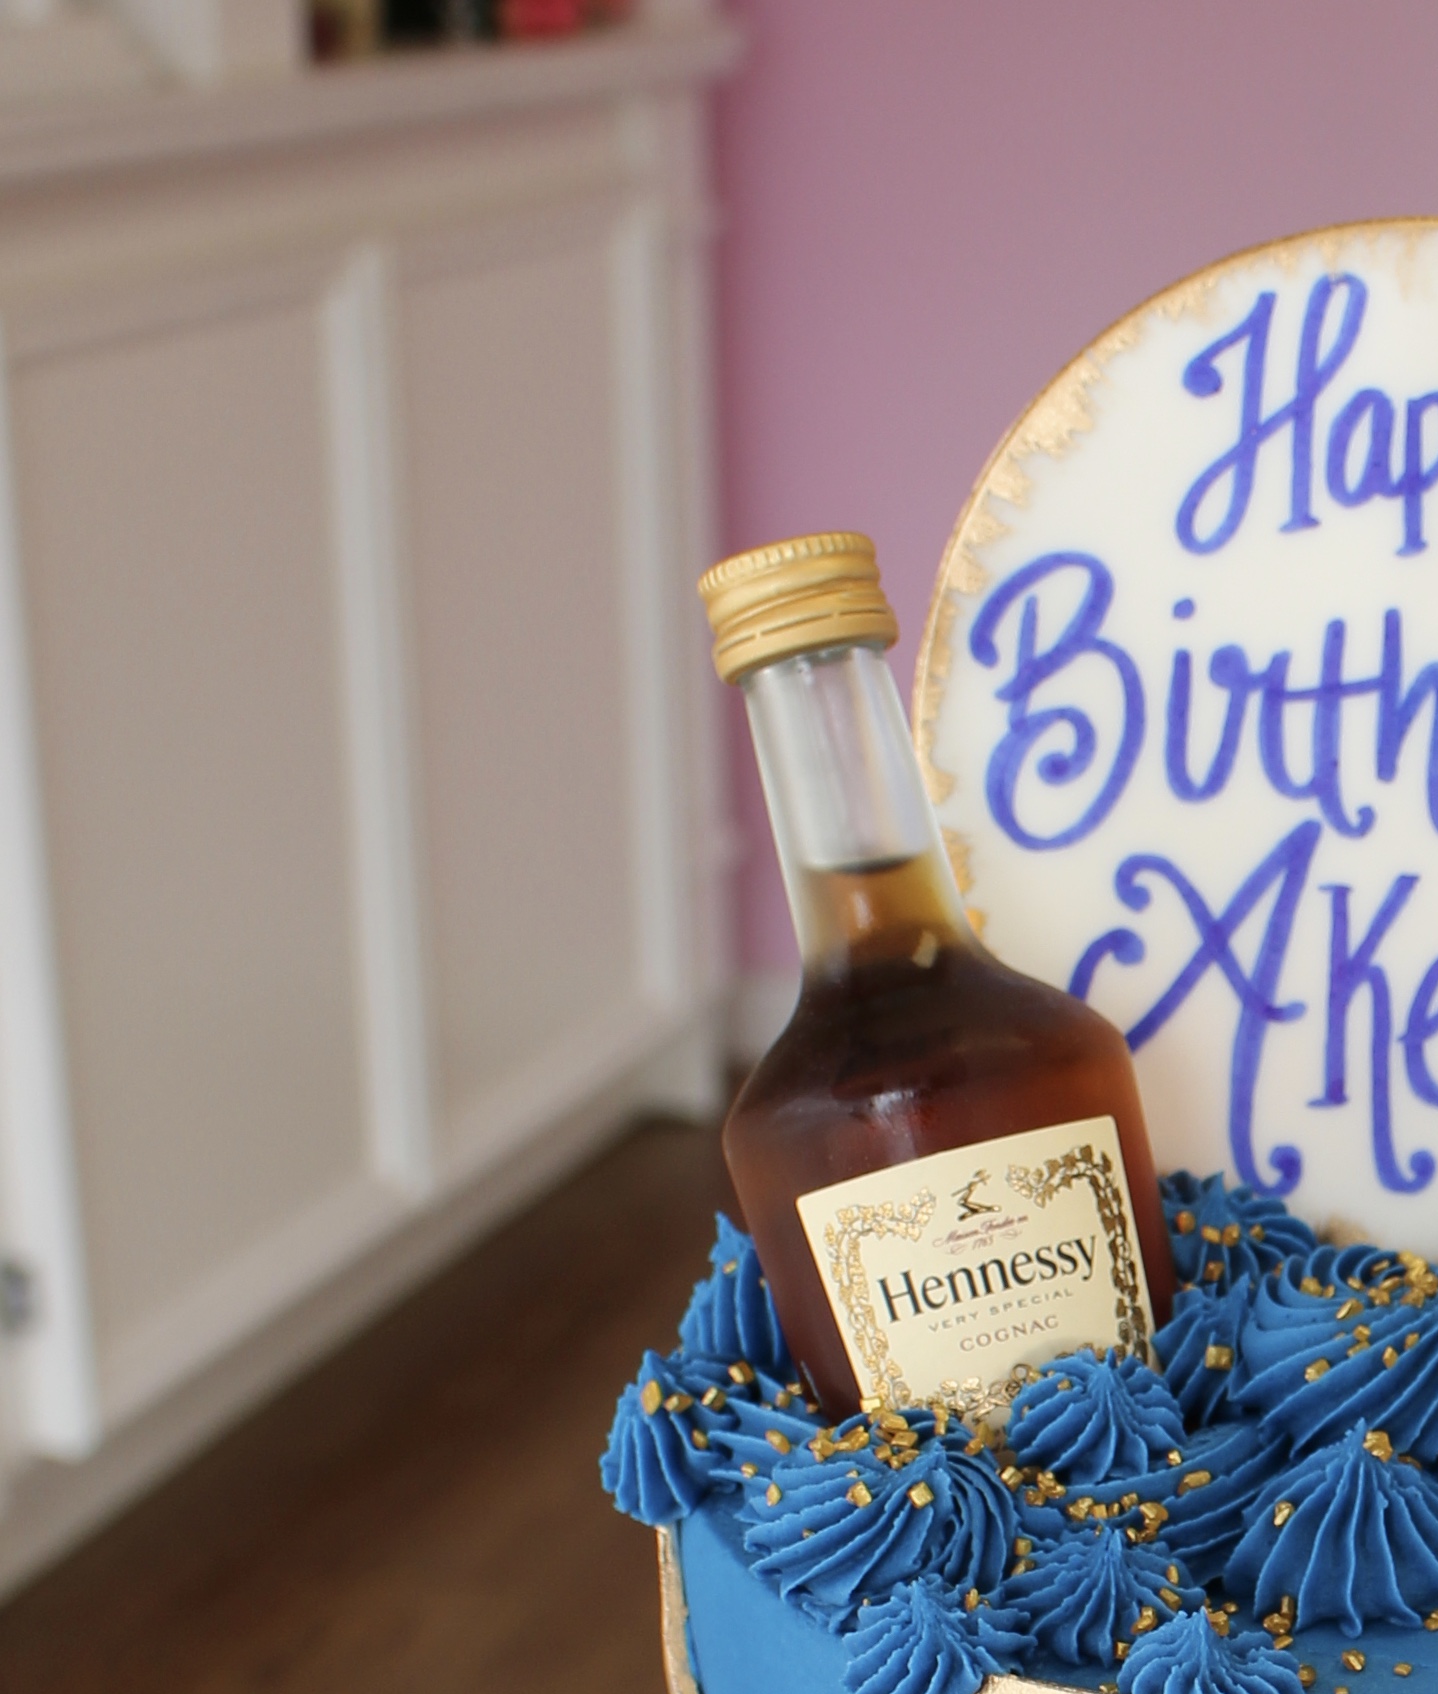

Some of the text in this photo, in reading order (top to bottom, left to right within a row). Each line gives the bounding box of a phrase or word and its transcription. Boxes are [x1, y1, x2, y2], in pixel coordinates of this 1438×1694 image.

[877, 1235, 1096, 1323] Hennessy
[928, 1288, 1073, 1333] VERY SPECIAL
[959, 1315, 1059, 1351] COGNAC
